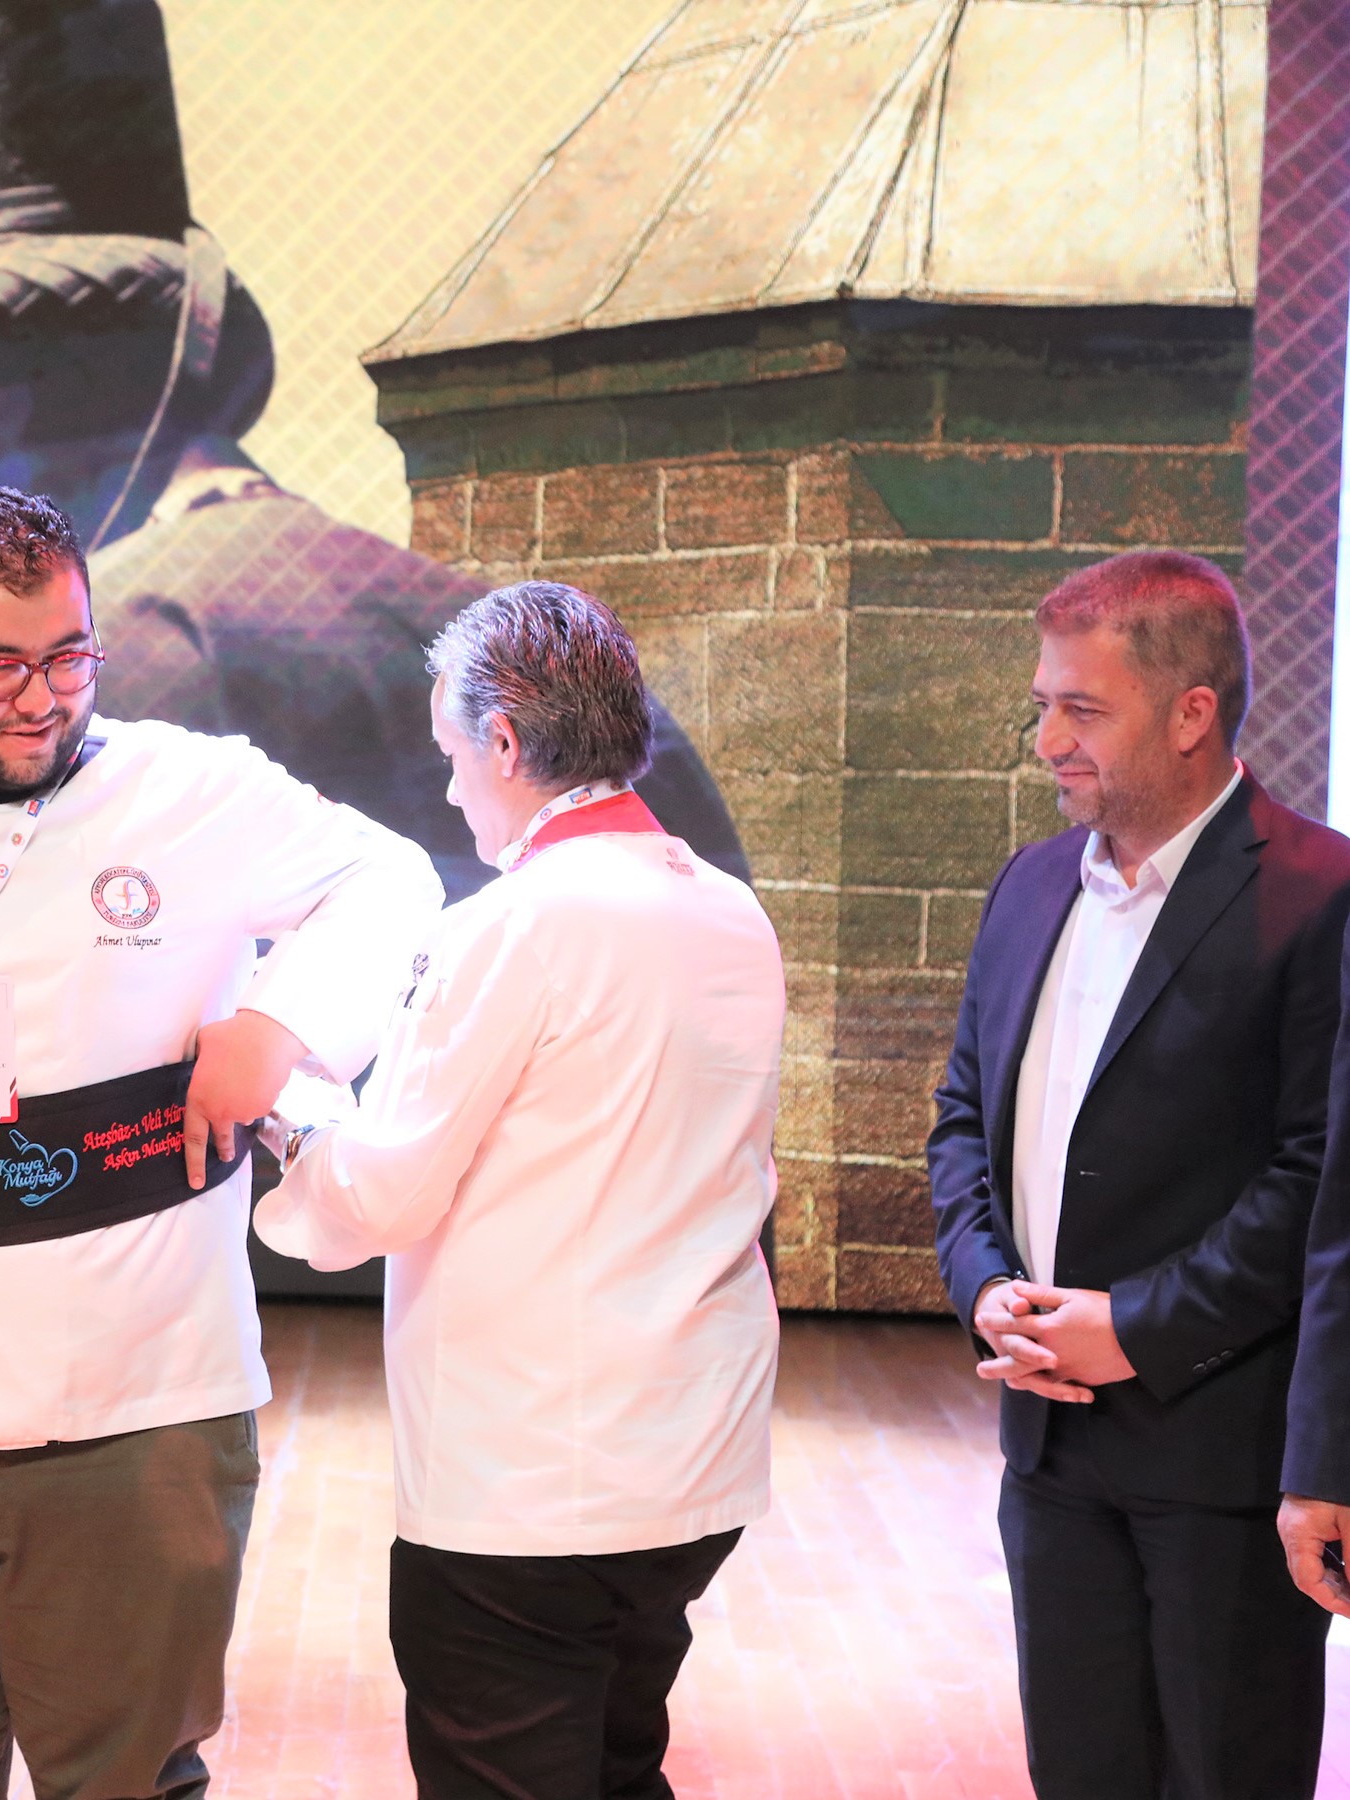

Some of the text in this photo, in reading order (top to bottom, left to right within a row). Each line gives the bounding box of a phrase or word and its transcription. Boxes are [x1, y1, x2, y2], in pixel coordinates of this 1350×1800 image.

[93, 934, 123, 948] Ahmet
[82, 1121, 141, 1153] Ateşbâz-ı
[141, 1108, 163, 1134] Veli
[102, 1146, 141, 1171] Aşkın
[2, 1167, 63, 1191] Mutfağı
